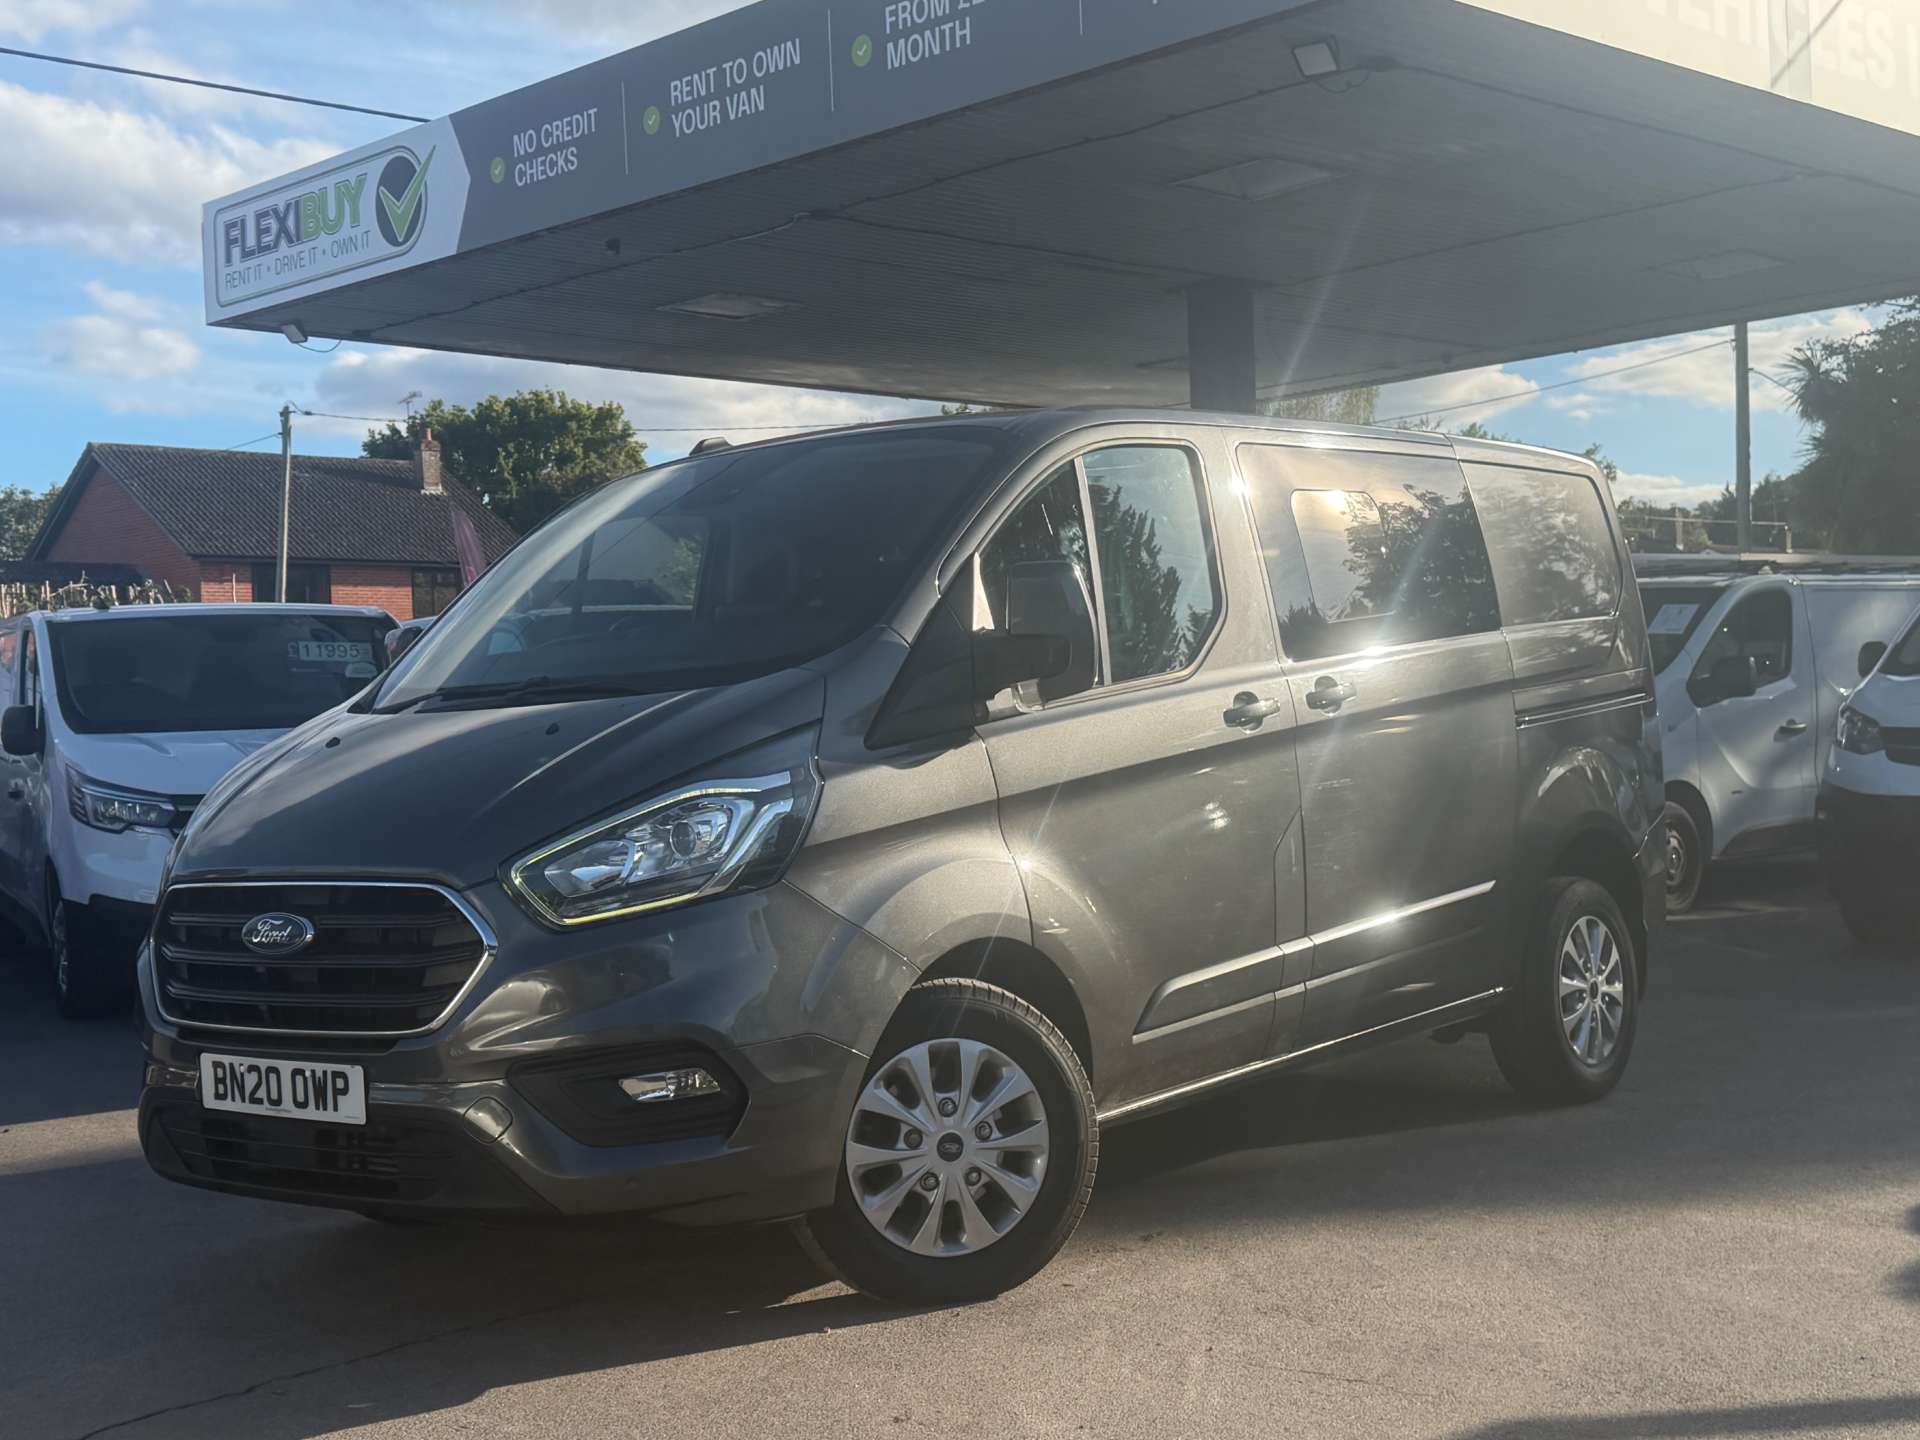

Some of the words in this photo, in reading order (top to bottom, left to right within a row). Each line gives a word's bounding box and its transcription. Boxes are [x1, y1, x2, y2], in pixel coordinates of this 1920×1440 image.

[885, 0, 950, 34] FROM
[887, 16, 971, 70] MONTH
[670, 67, 717, 106] RENT
[722, 58, 747, 88] TO
[752, 38, 800, 77] OWN
[512, 129, 537, 157] NO
[540, 108, 598, 148] CREDIT
[671, 99, 721, 138] YOUR
[726, 85, 765, 121] VAN
[514, 147, 578, 187] CHECKS
[225, 269, 253, 290] RENT
[253, 263, 263, 283] IT
[274, 253, 305, 276] DRIVE
[307, 246, 319, 265] IT
[330, 234, 359, 258] OWN
[361, 230, 372, 249] IT
[252, 918, 293, 943] Ford
[212, 1060, 283, 1107] BN20
[291, 1067, 349, 1113] OWP
